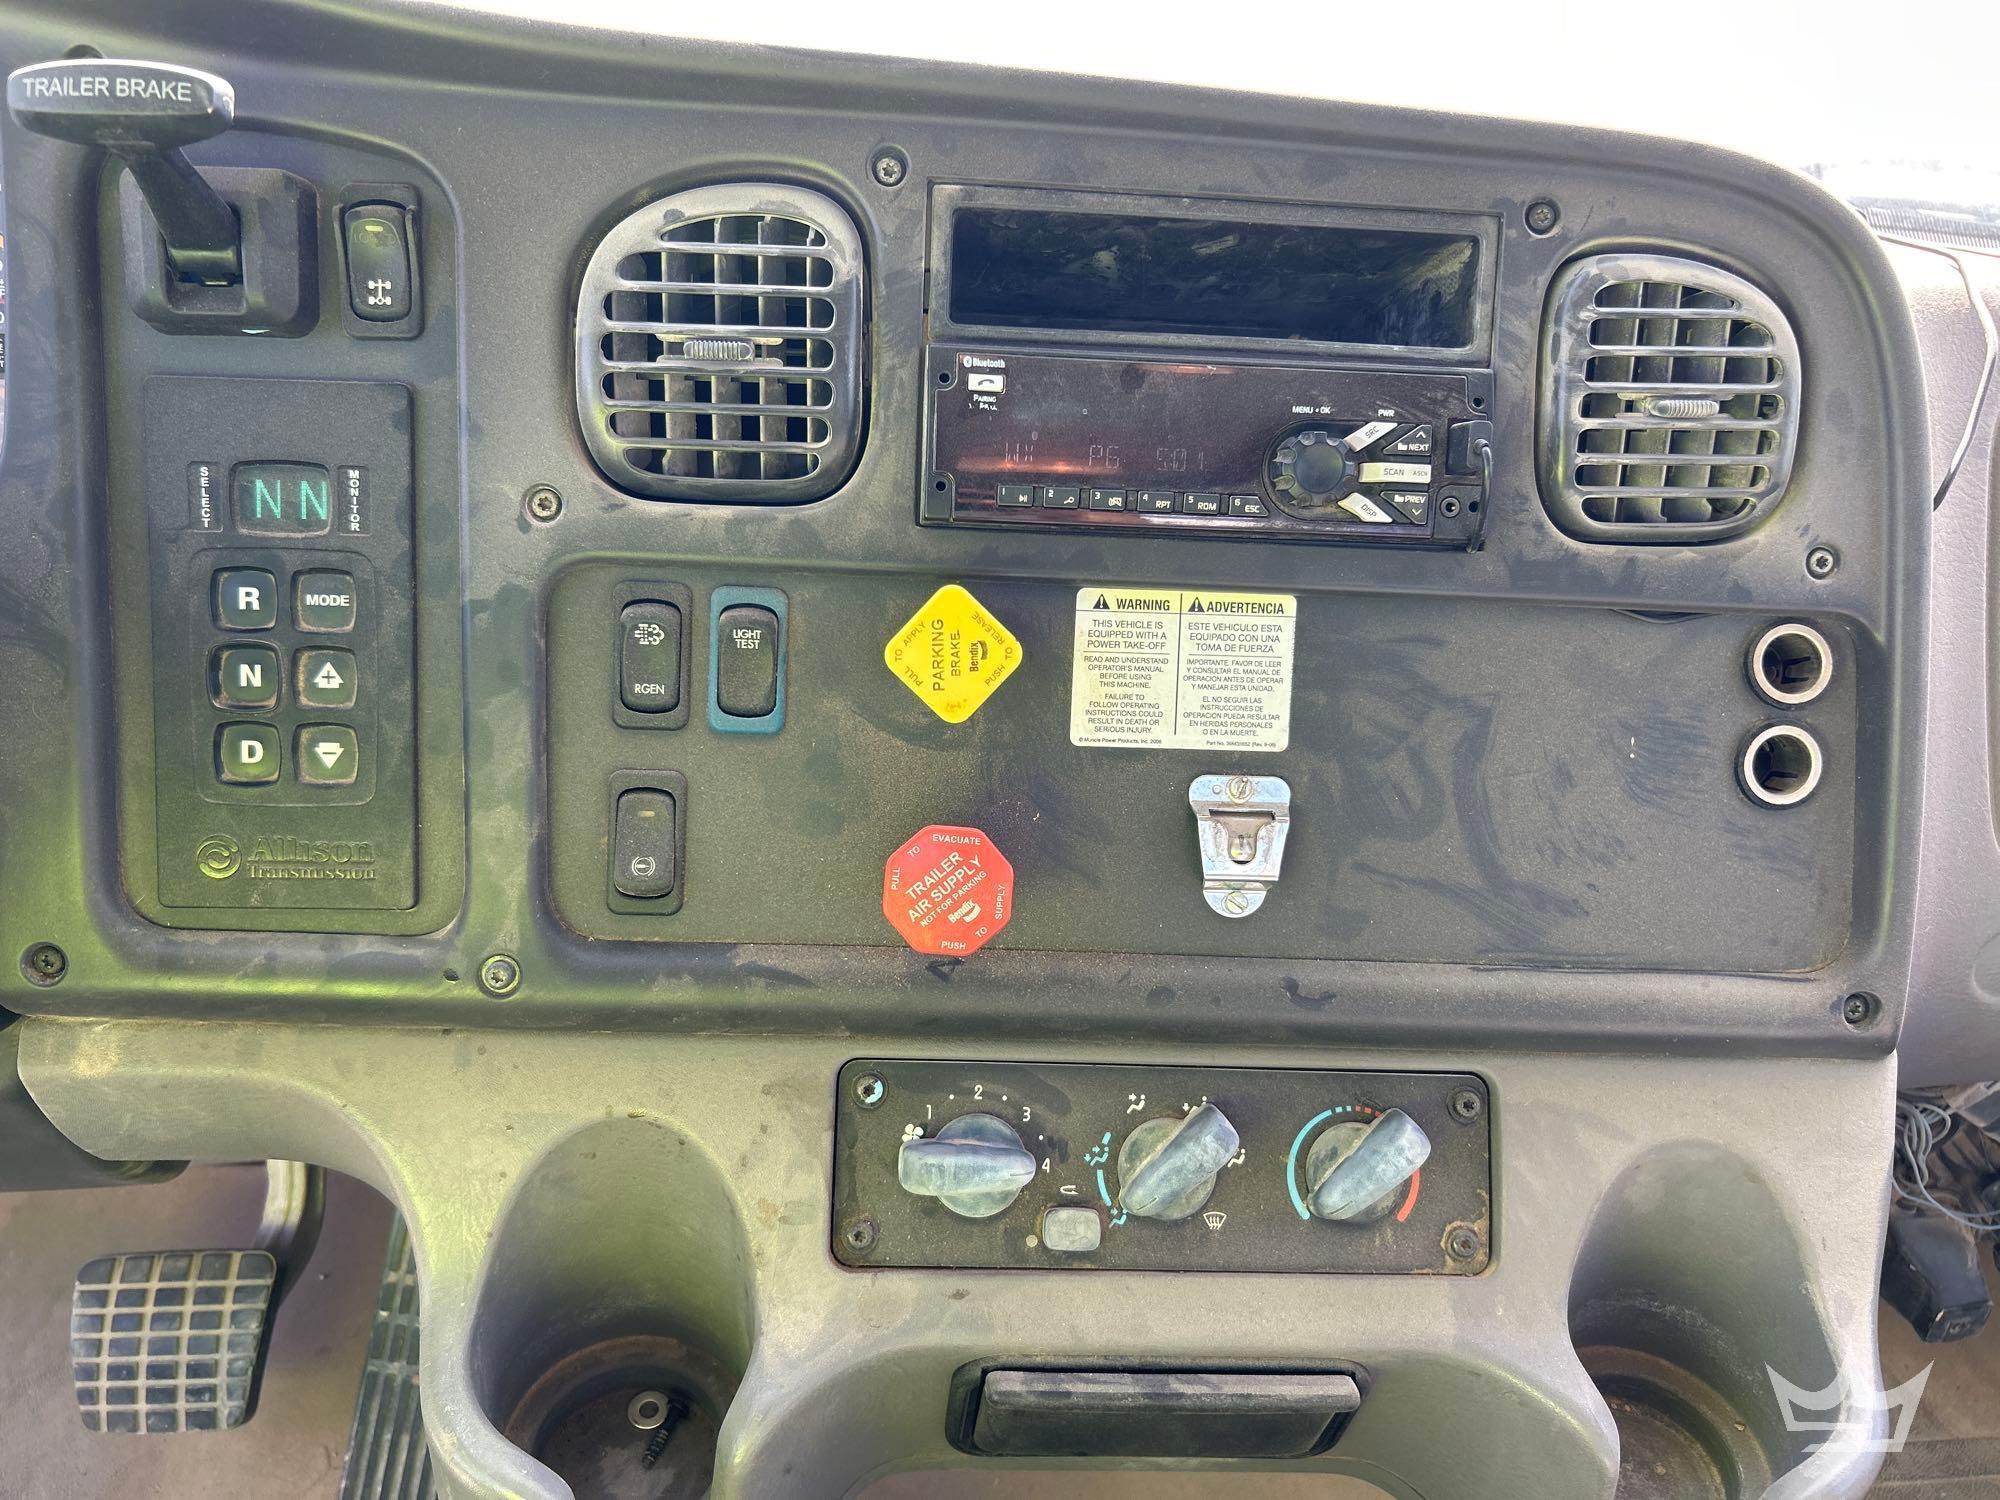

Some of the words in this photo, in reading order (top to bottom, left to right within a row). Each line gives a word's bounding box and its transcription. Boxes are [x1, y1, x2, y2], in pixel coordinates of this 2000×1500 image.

[22, 77, 110, 97] TRAILER
[116, 78, 192, 102] BRAKE
[973, 358, 1005, 368] Bluetooth
[1292, 406, 1313, 414] MENU
[1320, 406, 1330, 414] OK
[1378, 409, 1394, 417] PWR
[1365, 425, 1380, 438] SRC
[1408, 444, 1429, 452] NEXT
[1384, 468, 1404, 476] SCAN
[200, 466, 210, 528] SELECT
[255, 478, 281, 518] N
[301, 480, 328, 520] N
[1048, 489, 1054, 497] 2
[1094, 492, 1101, 500] 3
[350, 470, 360, 532] MONITOR
[1155, 501, 1171, 510] RPT
[1188, 496, 1194, 504] 5
[1234, 498, 1241, 506] 6
[1404, 496, 1426, 504] PREV
[1244, 504, 1260, 513] ESC
[1361, 504, 1378, 518] DISP
[238, 586, 260, 611] R
[306, 594, 350, 607] MODE
[1116, 598, 1170, 611] WARNING
[1206, 601, 1284, 614] ADVERTENCIA
[971, 611, 1006, 645] RELEASE
[1092, 620, 1113, 628] THIS
[1115, 620, 1152, 629] VEHICLE
[1155, 621, 1164, 630] IS
[1188, 622, 1211, 630] ESTE
[1213, 623, 1258, 632] VEHICULO
[1261, 624, 1283, 632] ESTA
[733, 629, 762, 640] LIGHT
[902, 620, 926, 648] APPLY
[1088, 630, 1134, 638] EQUIPPED
[1136, 632, 1158, 640] WITH
[1160, 632, 1167, 640] A
[1190, 632, 1236, 642] EQUIPADO
[1238, 634, 1258, 642] CON
[1261, 635, 1281, 643] UNA
[735, 639, 760, 650] TEST
[1087, 640, 1120, 648] POWER
[1123, 640, 1166, 650] TAKE-OFF
[1196, 643, 1222, 652] TOMA
[1224, 644, 1237, 652] DE
[1239, 644, 1274, 653] FUERZA
[894, 648, 903, 662] TO
[931, 618, 945, 692] PARKING
[950, 630, 962, 677] BRAKE
[969, 640, 980, 672] Bendix
[1005, 647, 1013, 660] TO
[1104, 656, 1120, 664] AND
[1254, 660, 1264, 668] DE
[1088, 664, 1133, 672] OPERATOR'S
[1242, 668, 1270, 676] MANUAL
[240, 664, 262, 688] N
[904, 665, 924, 687] PULL
[984, 664, 1006, 687] PUSH
[1100, 672, 1127, 680] BEFORE
[1129, 673, 1152, 681] USING
[634, 684, 665, 695] RGEN
[1099, 680, 1116, 688] THIS
[1089, 700, 1118, 708] FOLLOW
[1120, 702, 1160, 710] OPERATING
[1224, 696, 1248, 704] SEGUIR
[1085, 709, 1138, 717] INSTRUCTIONS
[1138, 710, 1164, 718] COULD
[1200, 704, 1254, 712] INSTRUCCIONES
[1125, 718, 1148, 726] DEATH
[1200, 720, 1228, 728] HERIDAS
[240, 740, 264, 764] D
[247, 836, 376, 863] Allison
[890, 867, 901, 890] PULL
[907, 845, 920, 857] TO
[932, 833, 981, 846] EVACUATE
[247, 863, 377, 880] Transmission
[905, 850, 964, 900] TRAILER
[907, 898, 933, 923] AIR
[931, 854, 982, 902] SUPPLY
[920, 913, 938, 928] NOT
[936, 898, 954, 914] FOR
[952, 870, 987, 900] PARKING
[941, 940, 967, 950] PUSH
[974, 926, 988, 938] TO
[995, 884, 1006, 920] SUPPLY
[947, 898, 976, 924] Bendix
[974, 1084, 984, 1100] 2
[926, 1104, 932, 1120] 1
[1022, 1106, 1031, 1122] 3
[1042, 1158, 1050, 1174] 4
